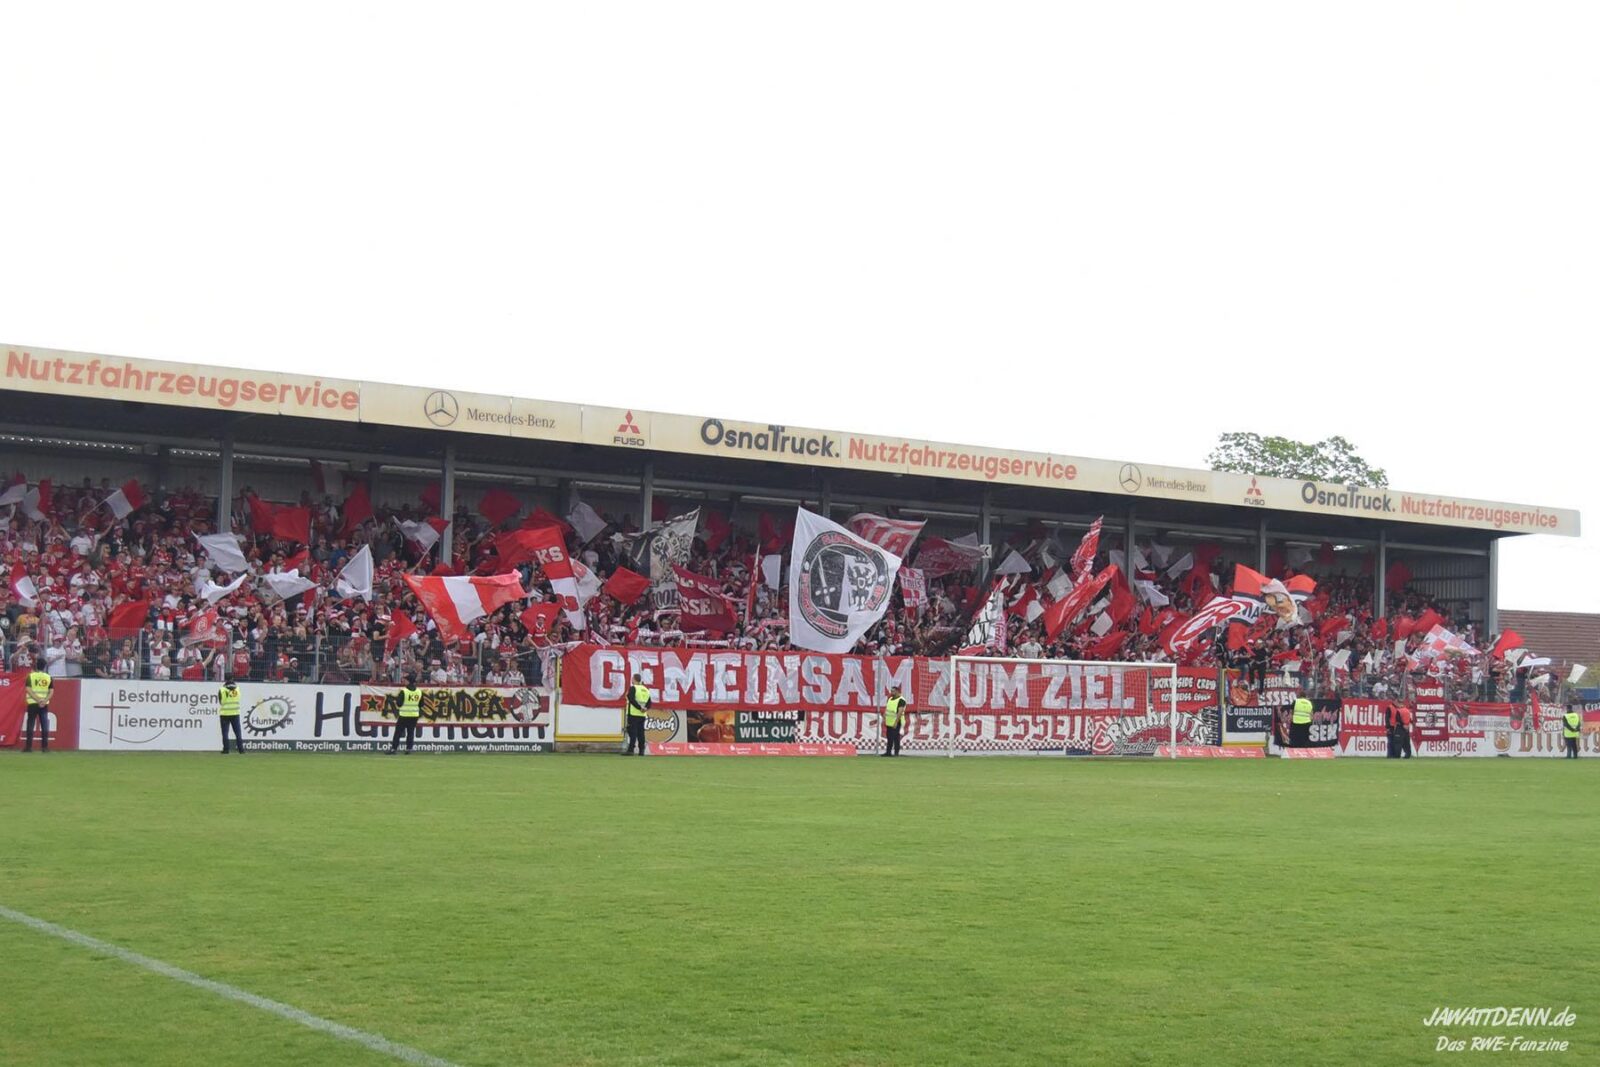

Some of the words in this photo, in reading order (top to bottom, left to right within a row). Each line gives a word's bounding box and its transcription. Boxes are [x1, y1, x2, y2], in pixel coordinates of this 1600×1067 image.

[6, 351, 361, 410] Nutzfahrzeugservice
[467, 408, 556, 429] Mercedes-Benz
[613, 436, 645, 447] FUSO
[848, 438, 1077, 480] Nutzfahrzeugservice
[1146, 477, 1207, 493] Mercedes-Benz
[1244, 498, 1266, 506] FUSO
[1401, 495, 1558, 529] Nutzfahrzeugservice
[35, 679, 48, 687] K9
[590, 650, 914, 706] GEMEINSAM
[928, 658, 1030, 709] ZUM
[1042, 662, 1135, 710] ZIEL
[119, 690, 218, 706] Bestattungen
[226, 688, 238, 698] K9
[408, 693, 420, 703] K9
[189, 707, 218, 716] GmbH
[1227, 704, 1272, 716] Commando
[118, 714, 203, 729] Lienemann
[251, 717, 294, 726] Huntmann
[1236, 717, 1263, 728] Essen
[739, 726, 769, 738] WILL
[242, 741, 292, 750] rdarbeiten,
[296, 741, 343, 752] Recycling,
[467, 743, 542, 752] www.huntmann.de
